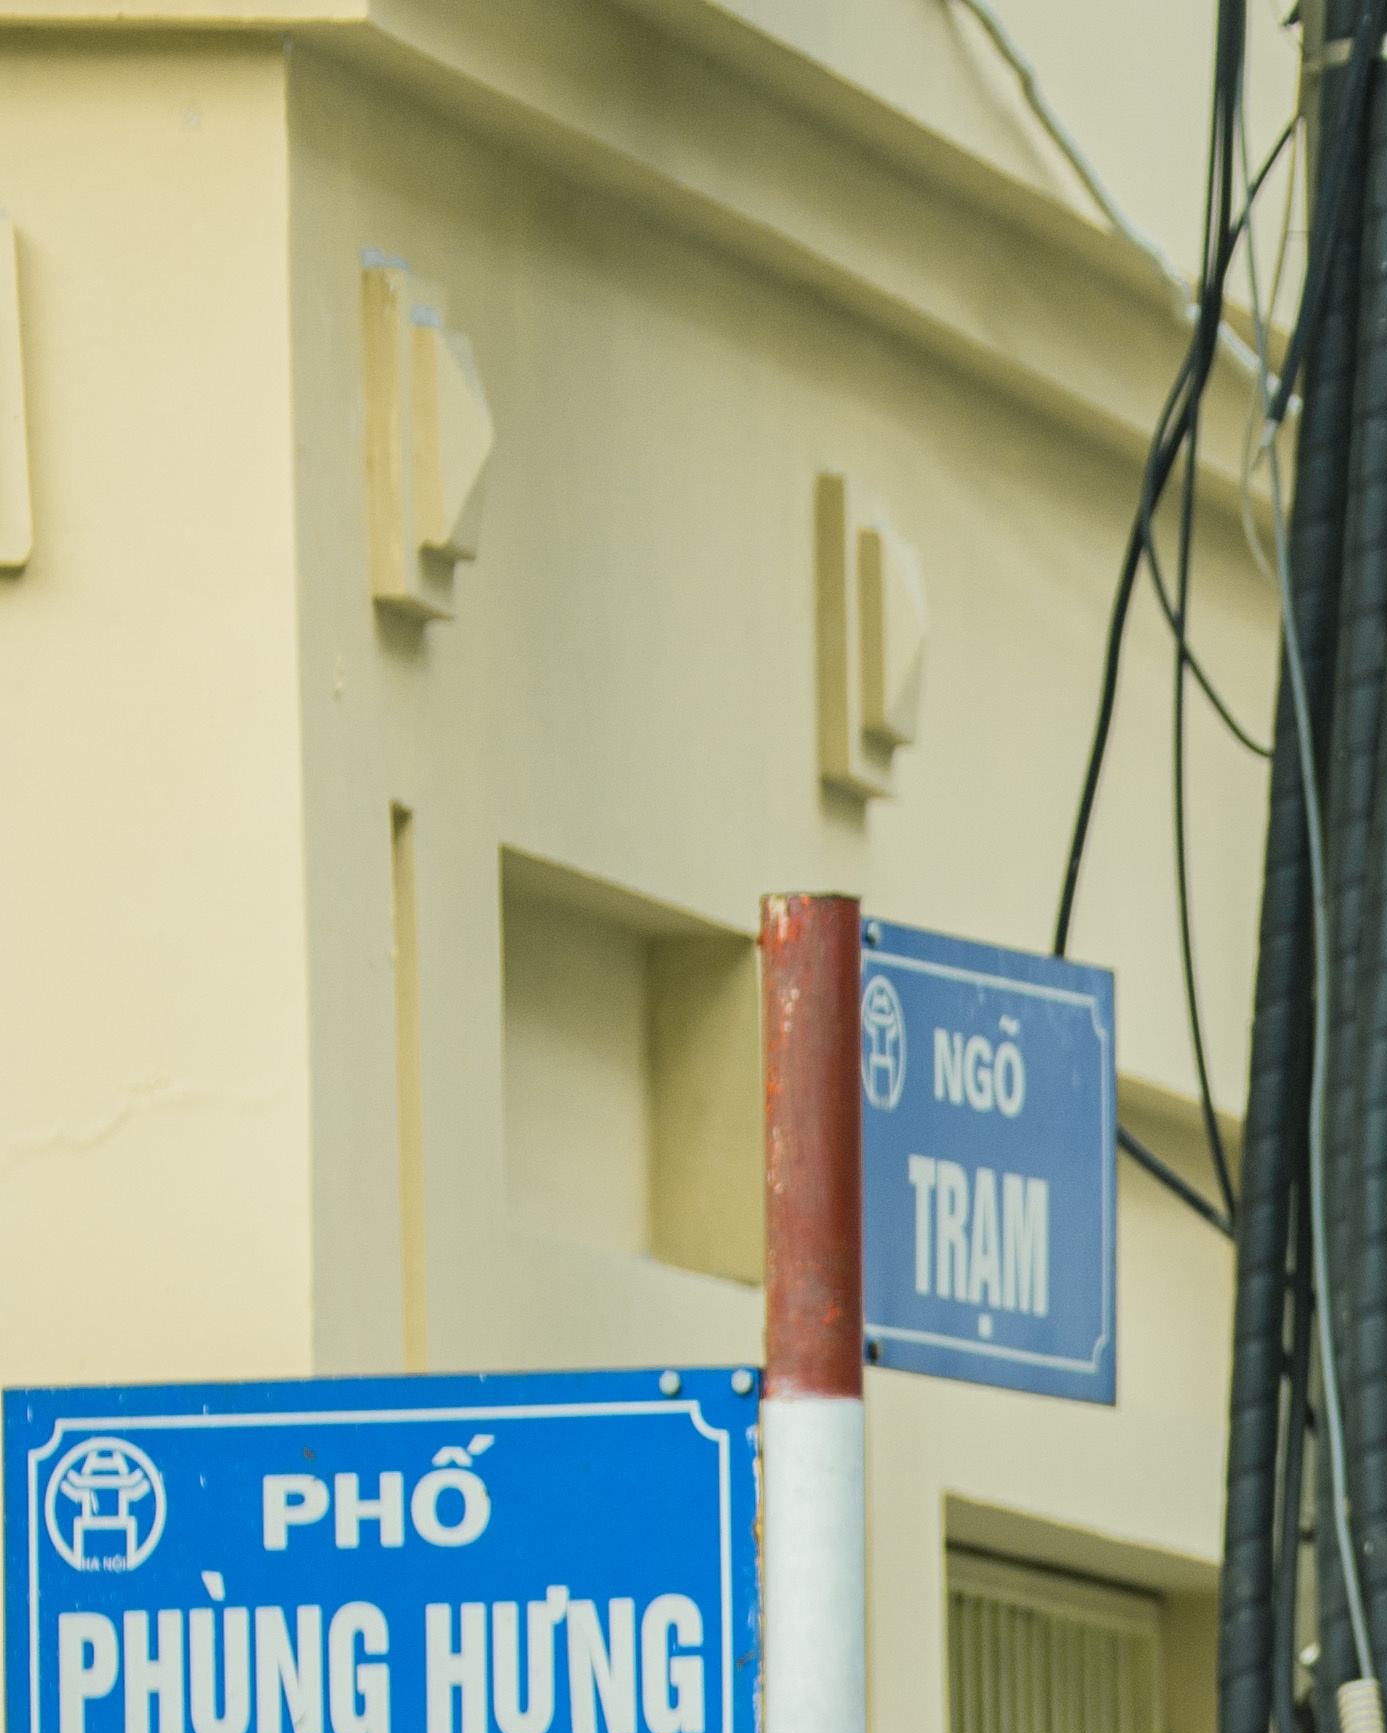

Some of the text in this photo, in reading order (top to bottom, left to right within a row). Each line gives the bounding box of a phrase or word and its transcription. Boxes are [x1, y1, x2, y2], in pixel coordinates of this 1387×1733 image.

[933, 1014, 1026, 1118] NGÕ
[908, 1154, 1050, 1339] TRẠM
[262, 1434, 495, 1551] PHỐ
